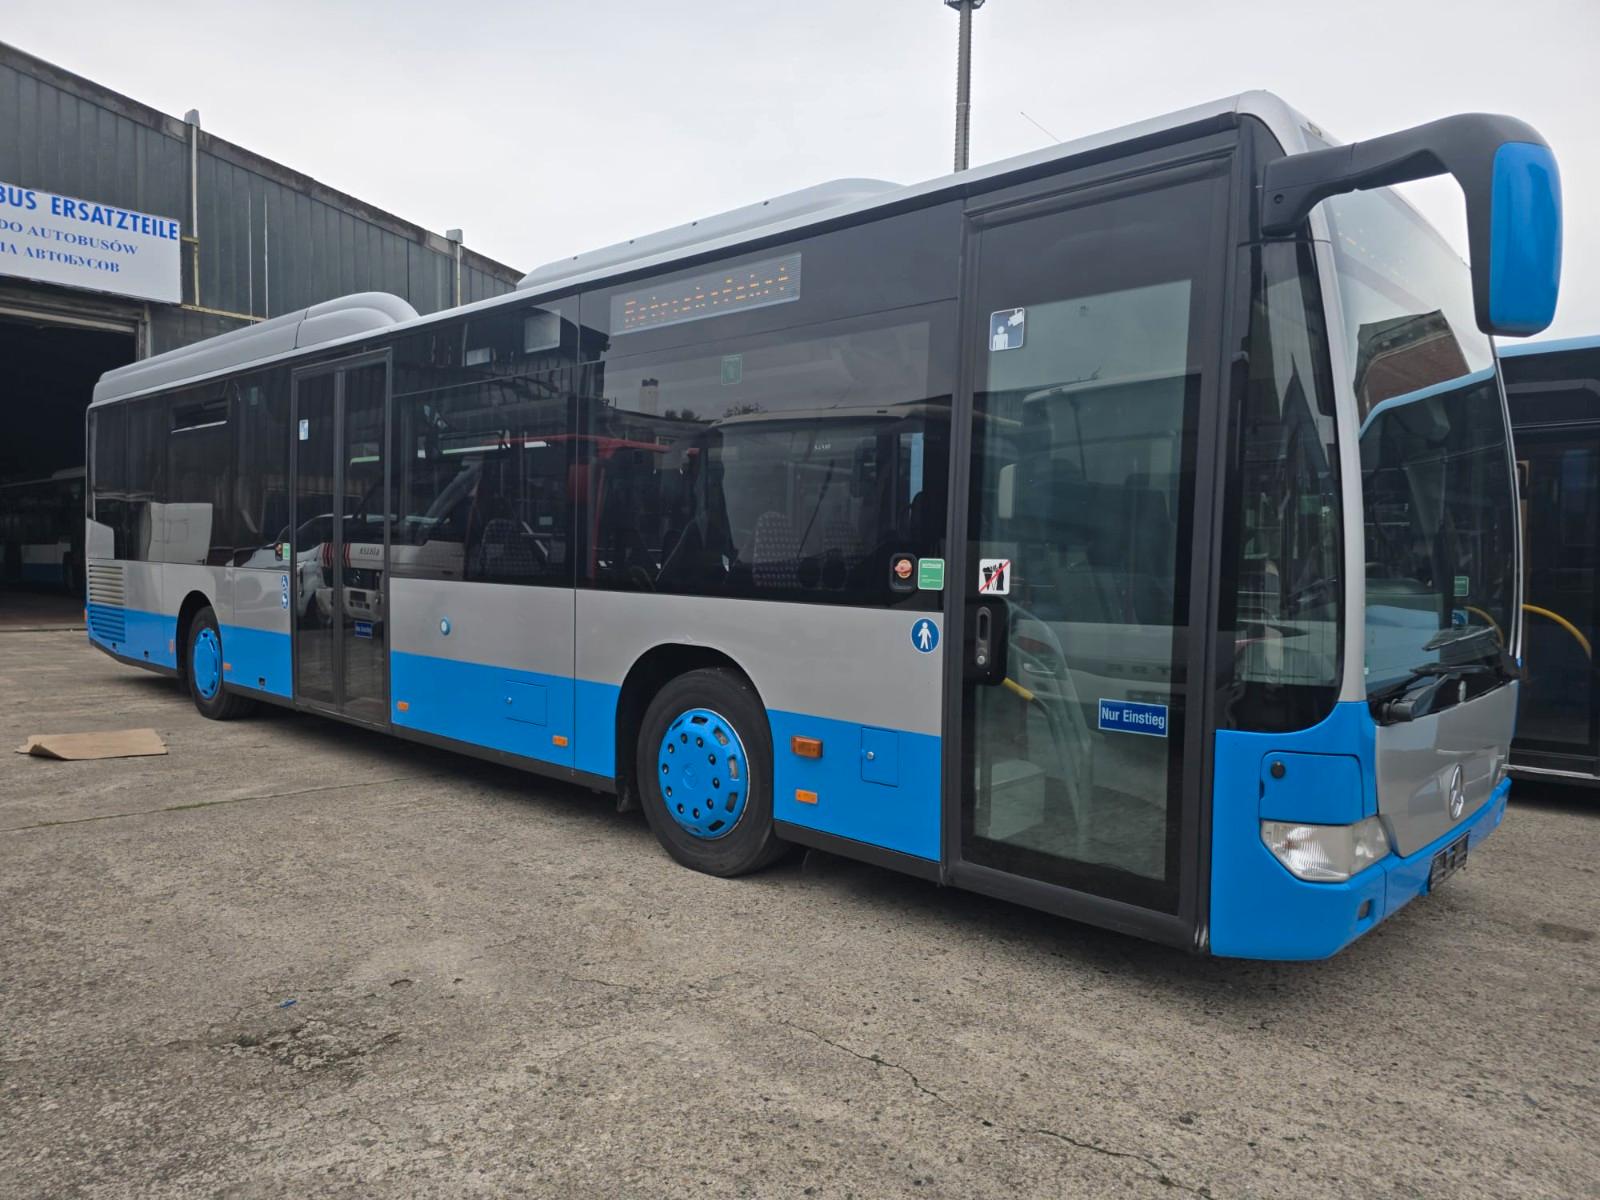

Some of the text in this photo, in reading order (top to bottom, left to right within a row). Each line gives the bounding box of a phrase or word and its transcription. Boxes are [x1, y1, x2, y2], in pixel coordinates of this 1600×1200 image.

[51, 196, 178, 240] ERSATZTEILE
[27, 226, 138, 255] AUTOBUSÓW
[1101, 707, 1165, 729] Nur Einstieg
